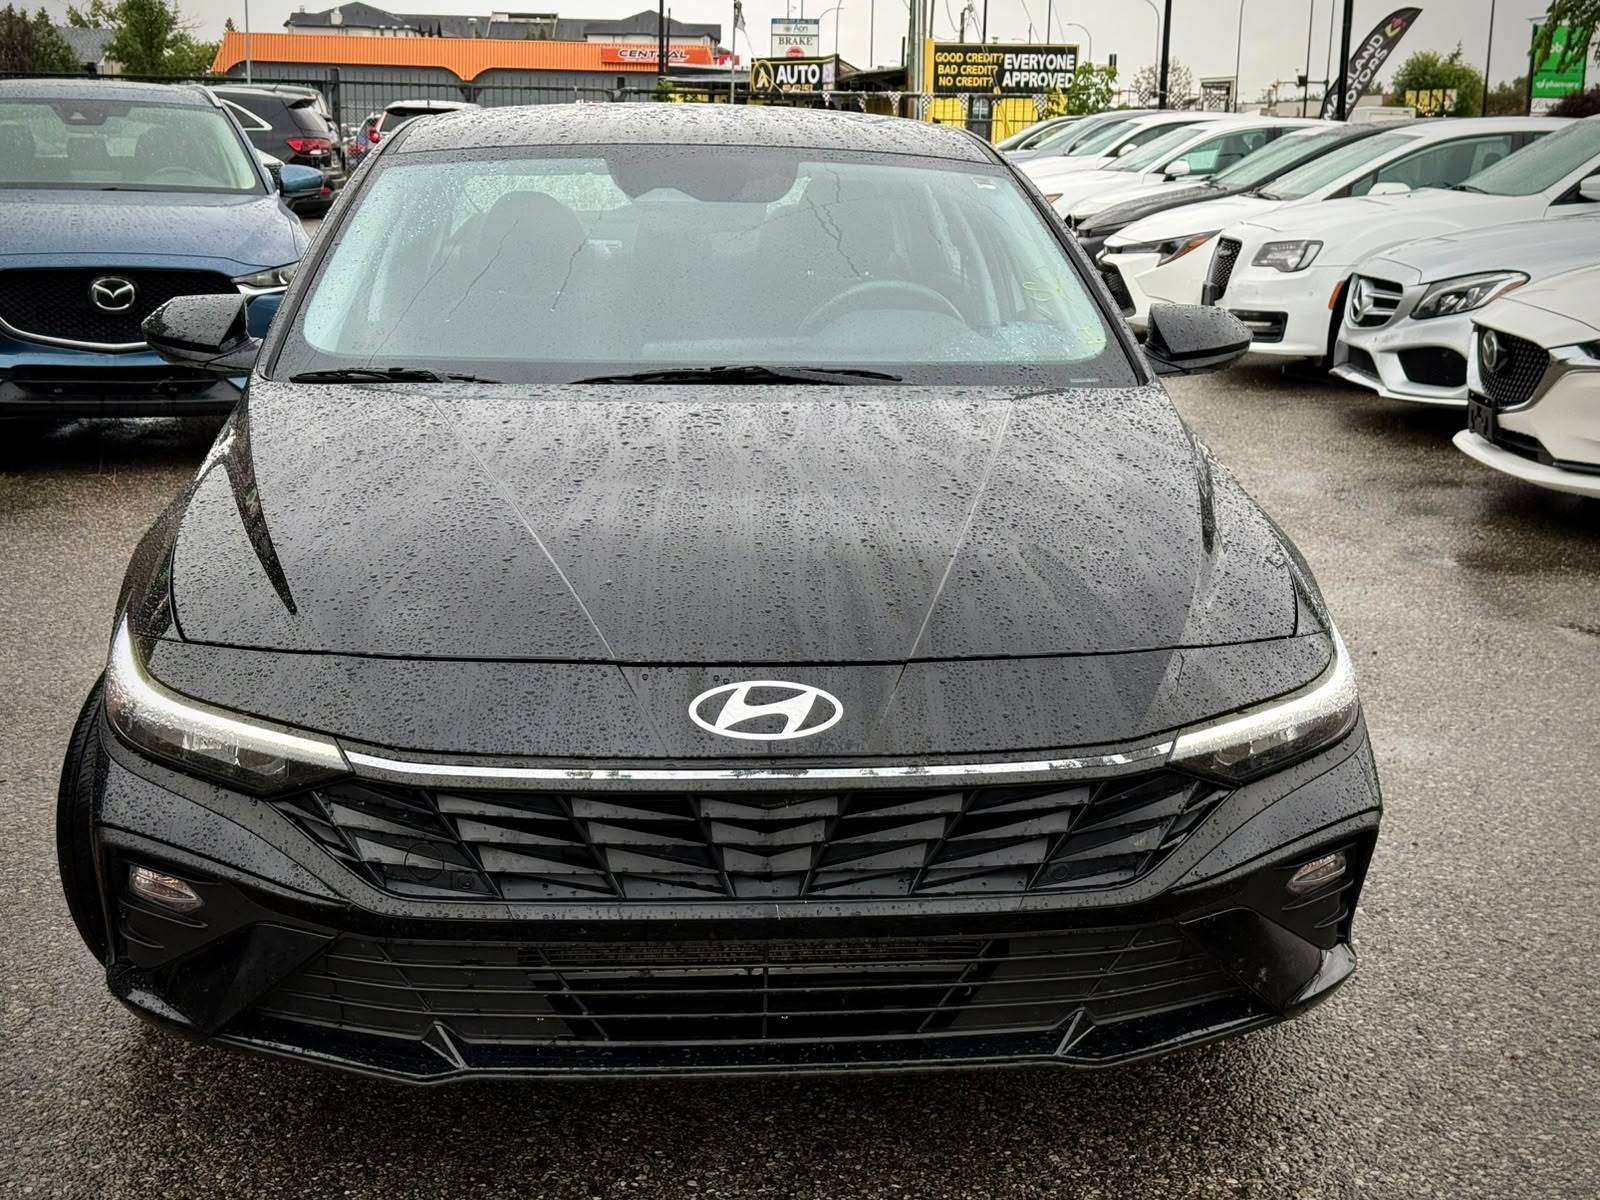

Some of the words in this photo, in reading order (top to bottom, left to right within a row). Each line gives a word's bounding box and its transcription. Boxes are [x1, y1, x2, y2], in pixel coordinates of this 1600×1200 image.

[778, 36, 813, 46] BRAKE
[619, 49, 688, 58] CENTAL
[935, 52, 963, 63] GOOD
[966, 52, 1003, 63] CREDIT?
[1004, 53, 1075, 70] EVERYONE
[776, 64, 820, 84] AUTO
[937, 64, 959, 74] BAD
[961, 64, 998, 75] CREDIT?
[939, 76, 953, 86] NO
[955, 76, 993, 87] CREDIT?
[1002, 72, 1074, 88] APPROVED
